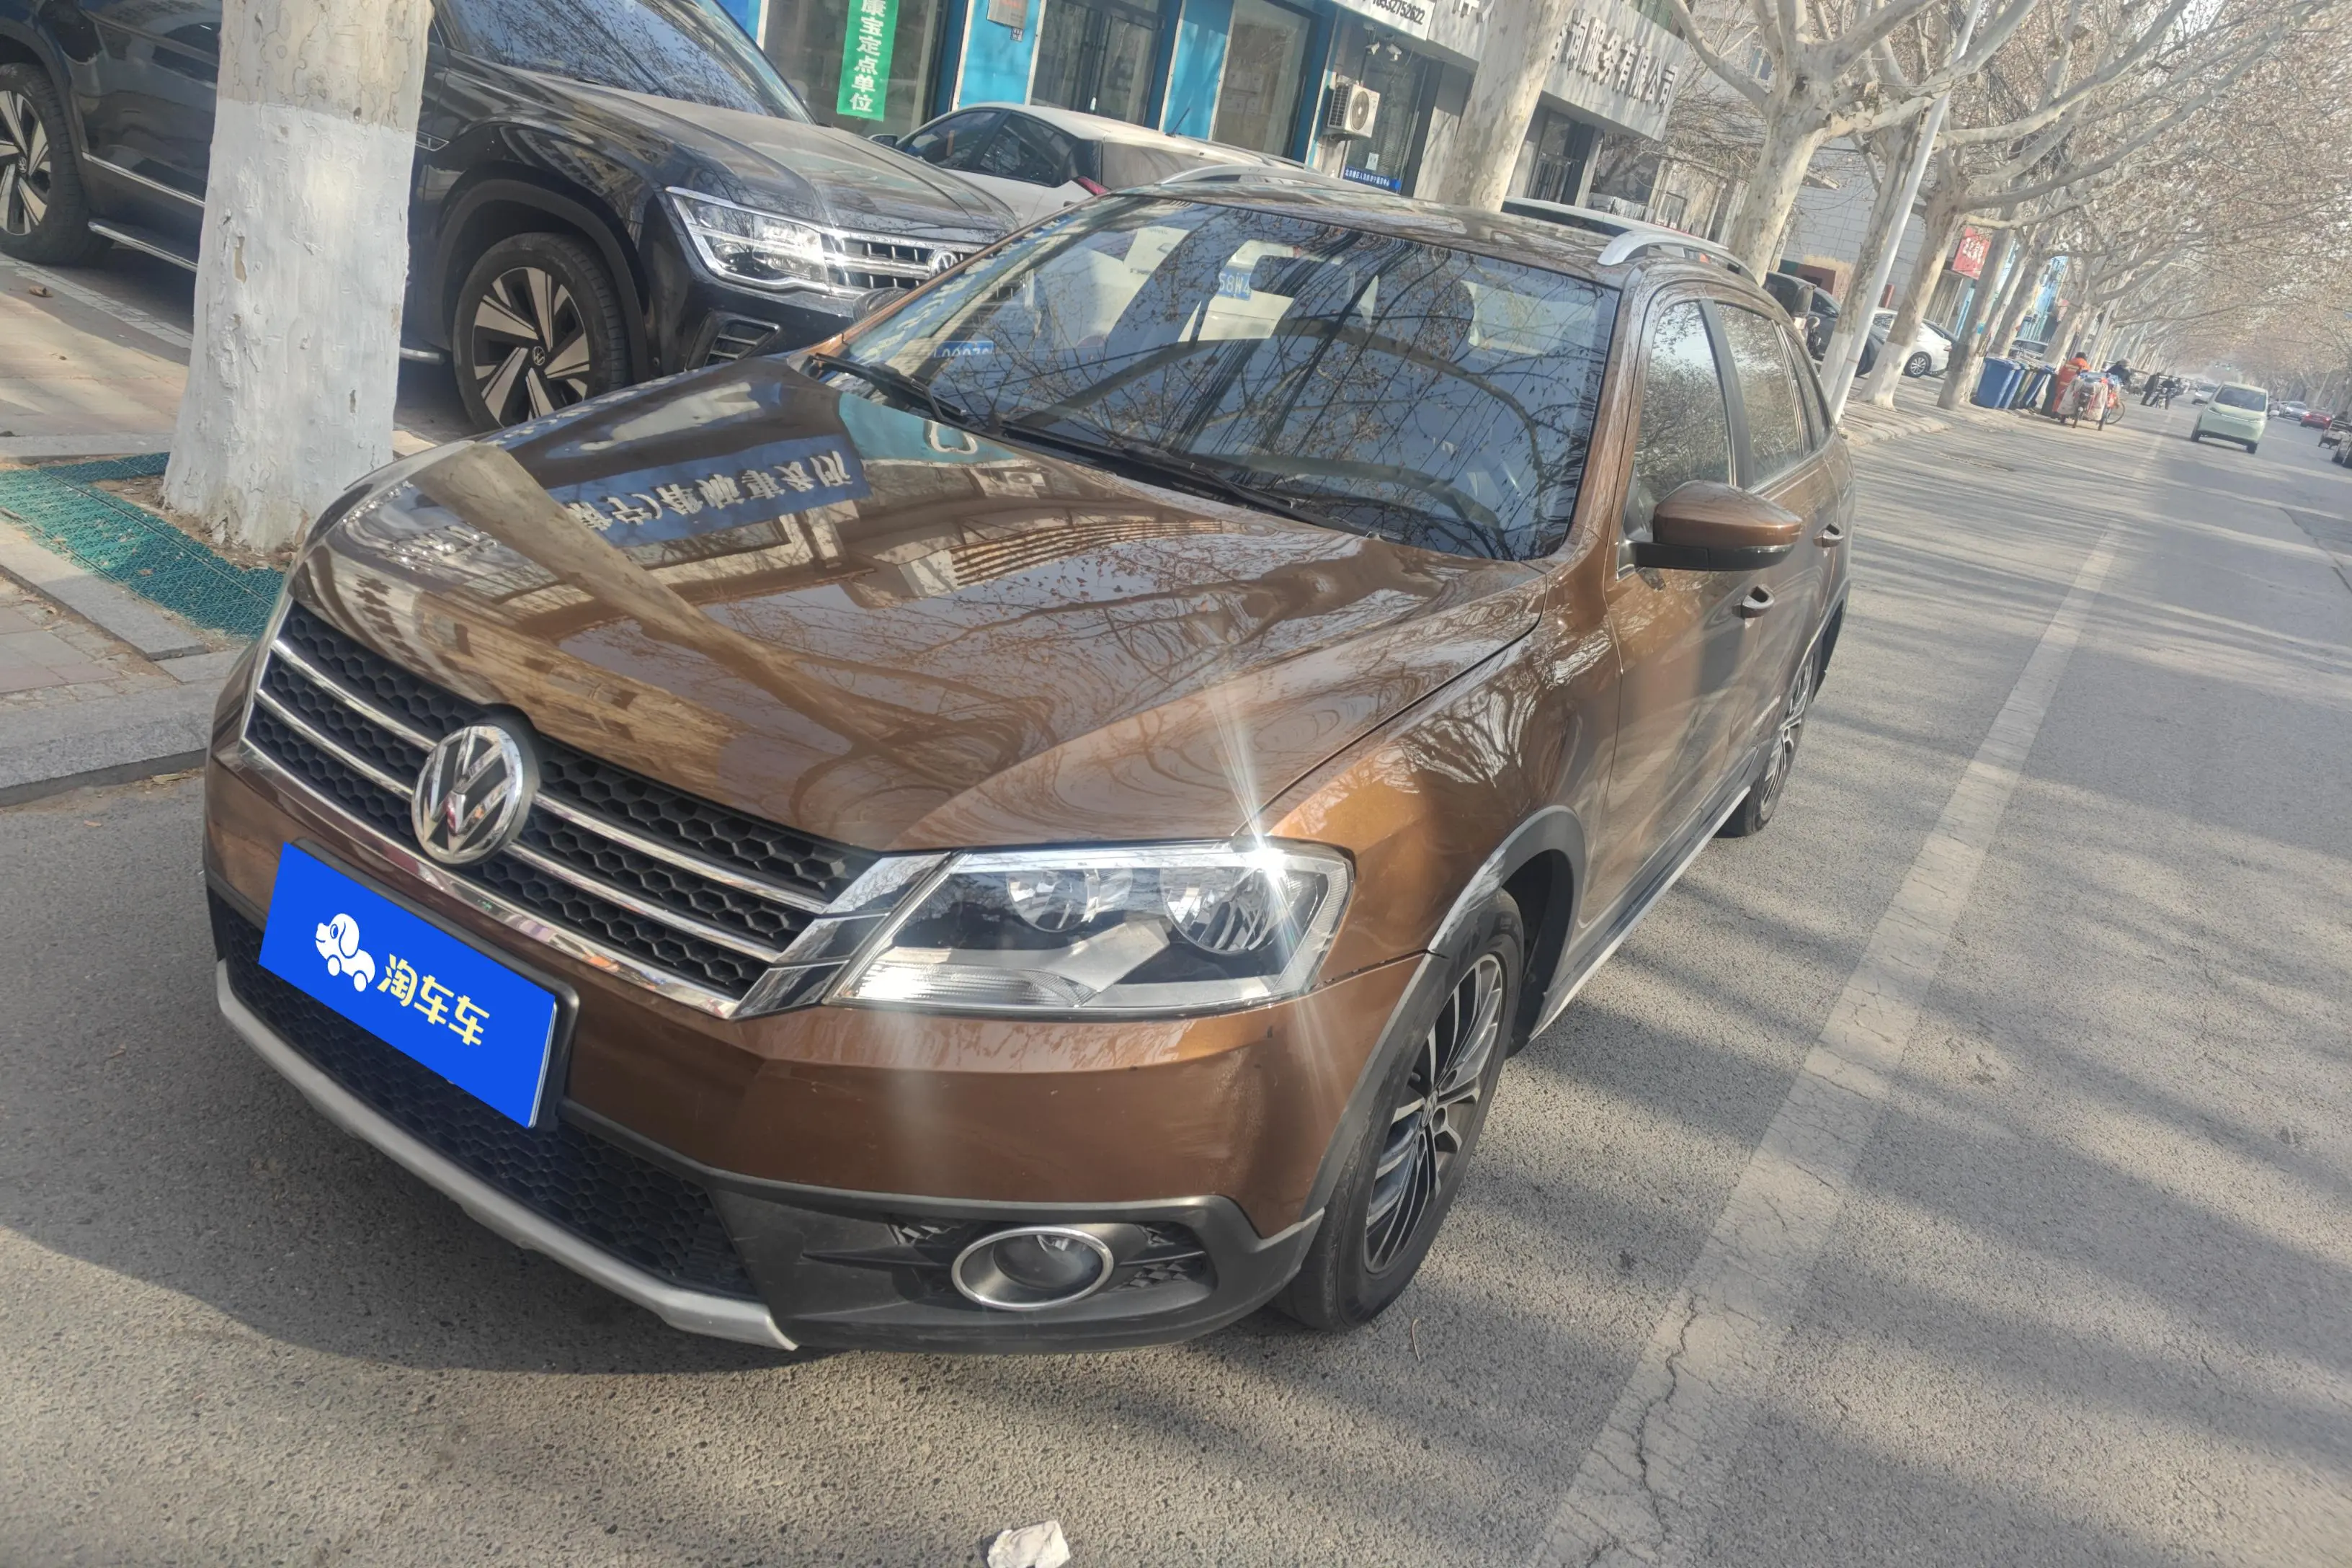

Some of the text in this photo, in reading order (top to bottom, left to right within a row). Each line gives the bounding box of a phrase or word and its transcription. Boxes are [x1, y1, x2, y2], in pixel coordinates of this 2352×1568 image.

[849, 0, 886, 112] 康宝定点单位
